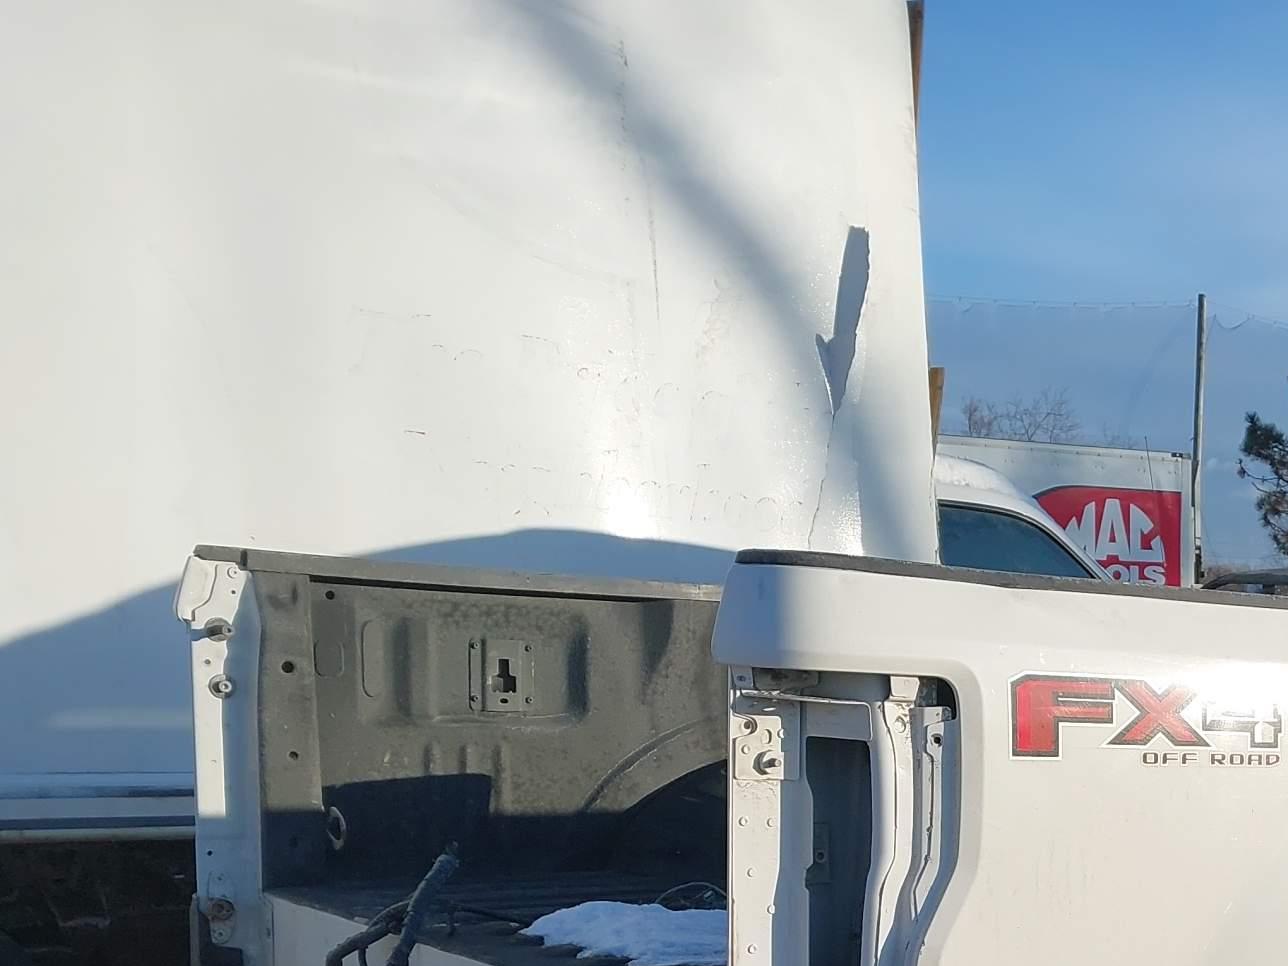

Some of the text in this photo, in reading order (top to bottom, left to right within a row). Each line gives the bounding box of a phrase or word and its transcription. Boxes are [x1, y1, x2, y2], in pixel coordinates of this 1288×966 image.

[1064, 498, 1165, 563] MAC
[1104, 564, 1167, 586] OLS
[1009, 673, 1283, 759] FX4
[1142, 751, 1281, 767] OFF ROAD
